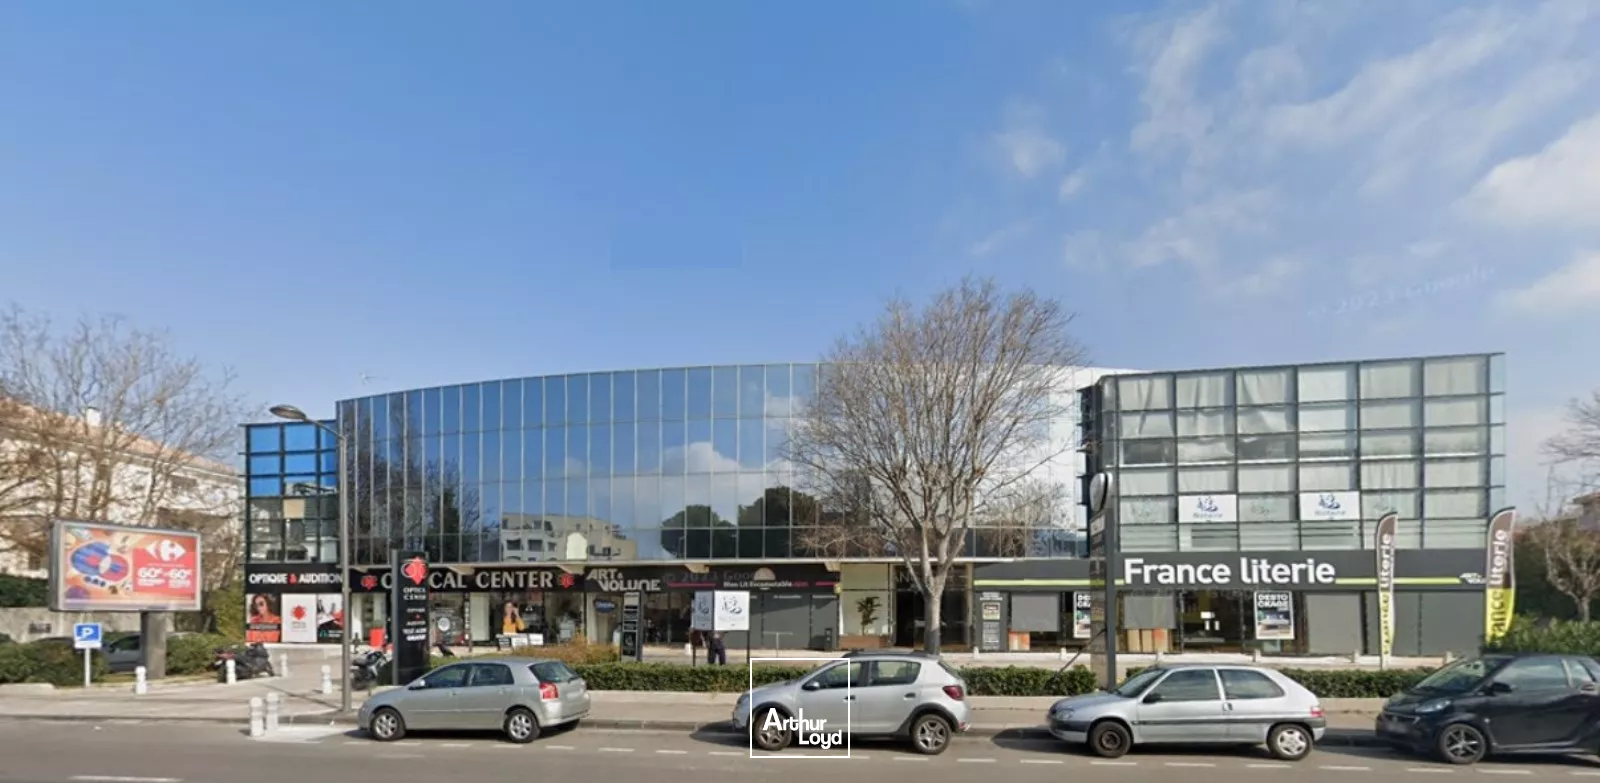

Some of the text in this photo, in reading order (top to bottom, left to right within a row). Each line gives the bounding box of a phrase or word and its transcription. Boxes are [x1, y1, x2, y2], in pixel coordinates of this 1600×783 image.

[586, 568, 618, 580] ART
[1124, 557, 1336, 585] France literie
[249, 573, 288, 584] OPTIQUE
[298, 573, 343, 584] AUDITION
[475, 571, 553, 588] CENTER
[82, 627, 94, 639] P
